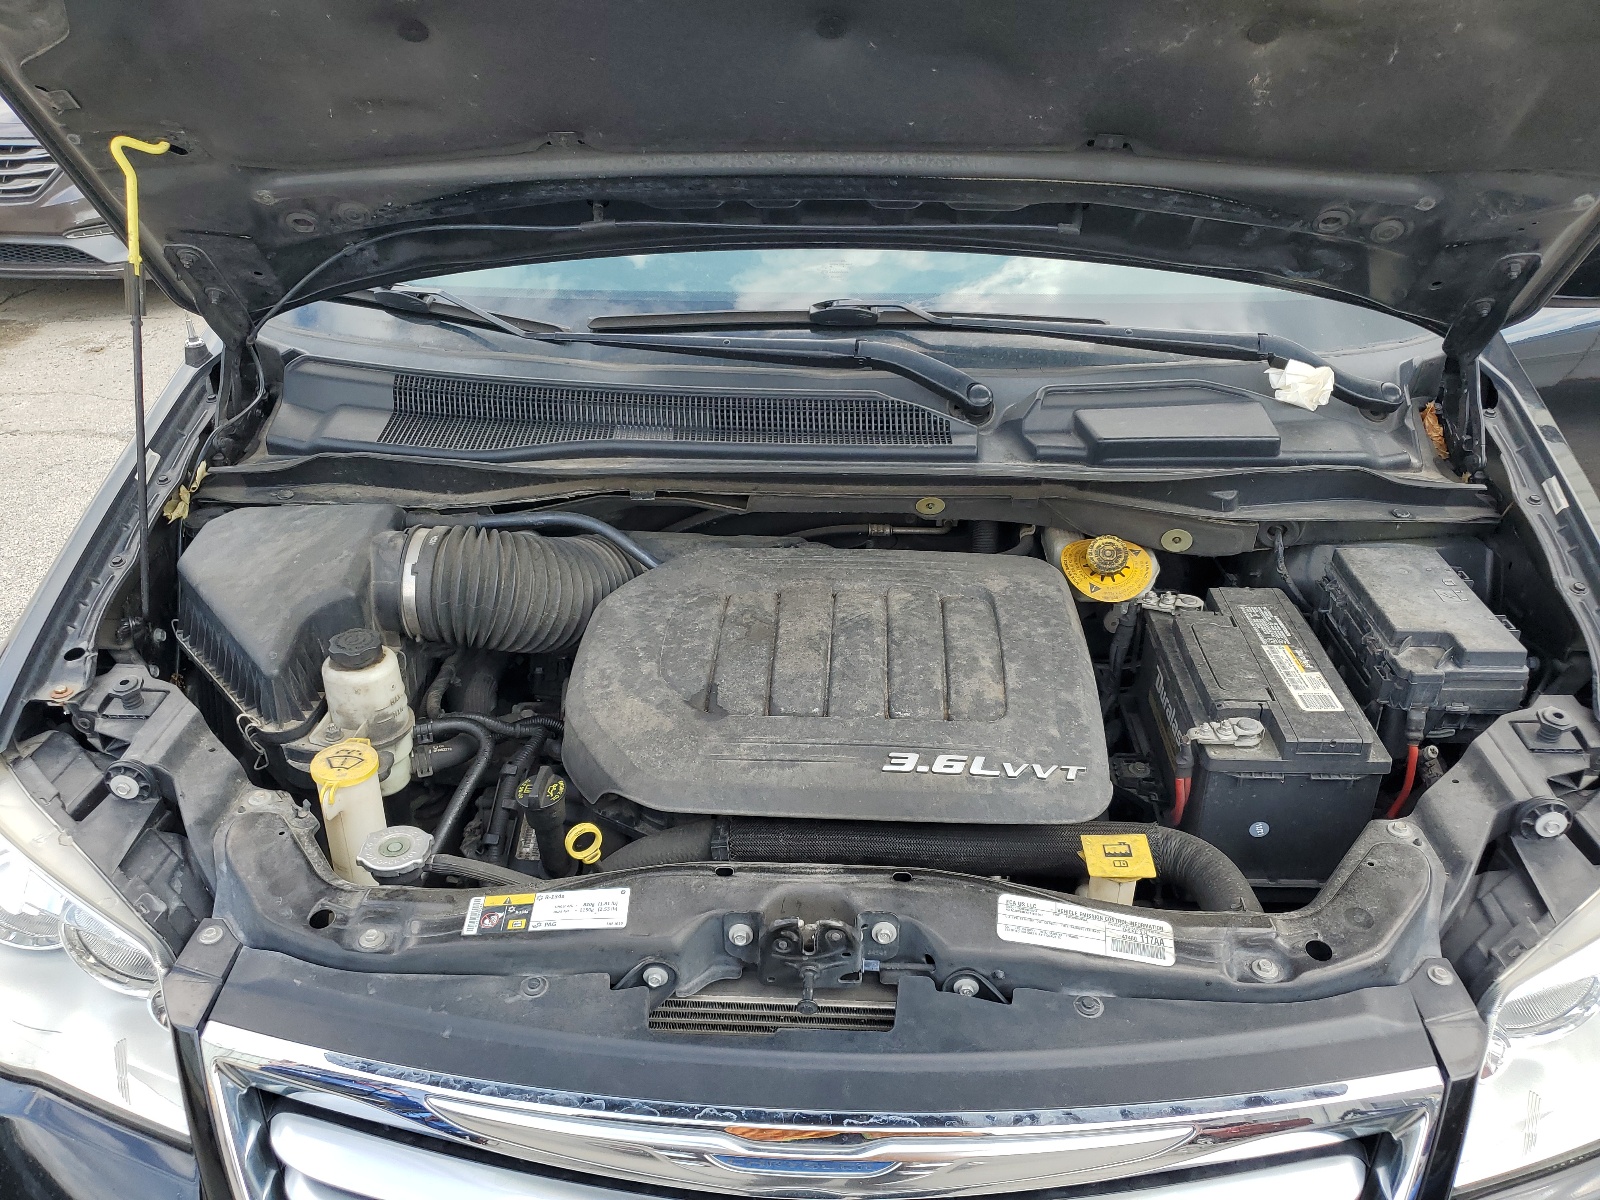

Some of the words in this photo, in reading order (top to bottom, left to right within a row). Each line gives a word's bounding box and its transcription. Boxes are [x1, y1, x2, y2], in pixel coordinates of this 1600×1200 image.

[1155, 664, 1183, 752] Duralas
[881, 752, 1001, 777] 3.6L
[1003, 762, 1088, 782] VVT
